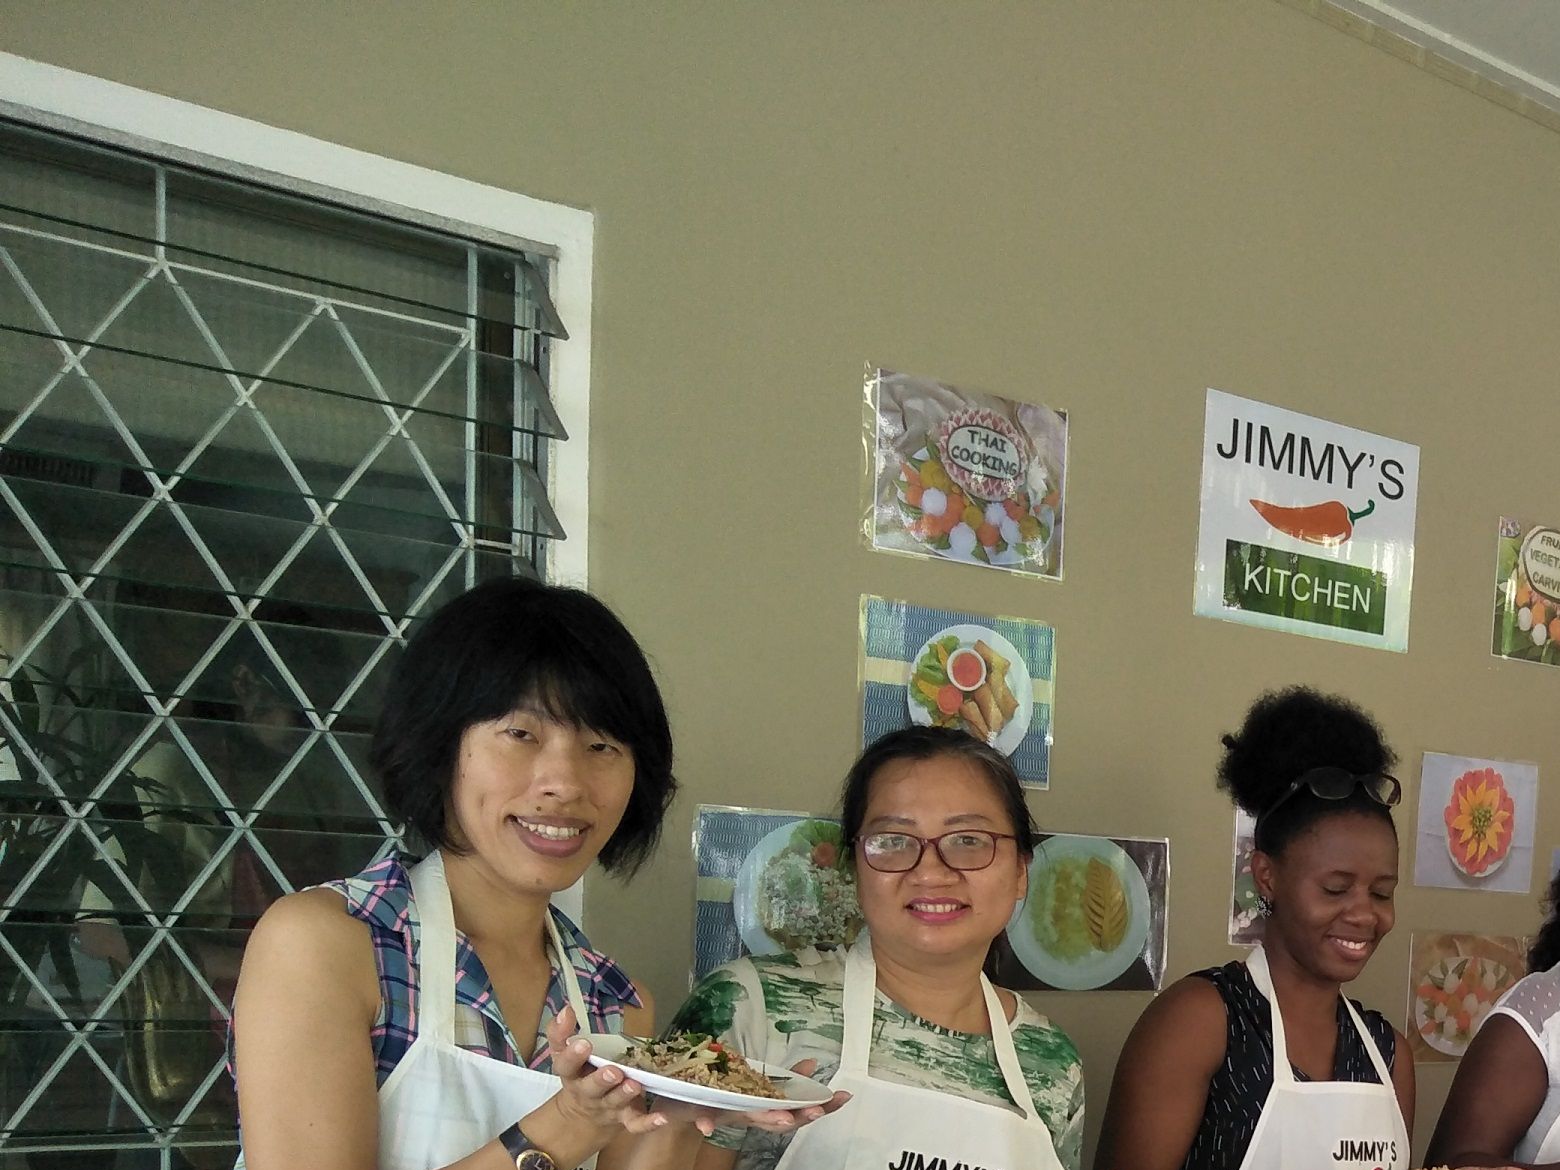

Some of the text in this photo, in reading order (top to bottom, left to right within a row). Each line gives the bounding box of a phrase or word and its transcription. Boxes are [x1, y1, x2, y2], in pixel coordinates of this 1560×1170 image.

[968, 429, 1007, 453] THAI
[951, 445, 1017, 476] COOKING
[1216, 418, 1405, 500] JIMMY'S
[1244, 563, 1371, 614] KITCHEN
[1332, 1140, 1397, 1162] JIMMY'S
